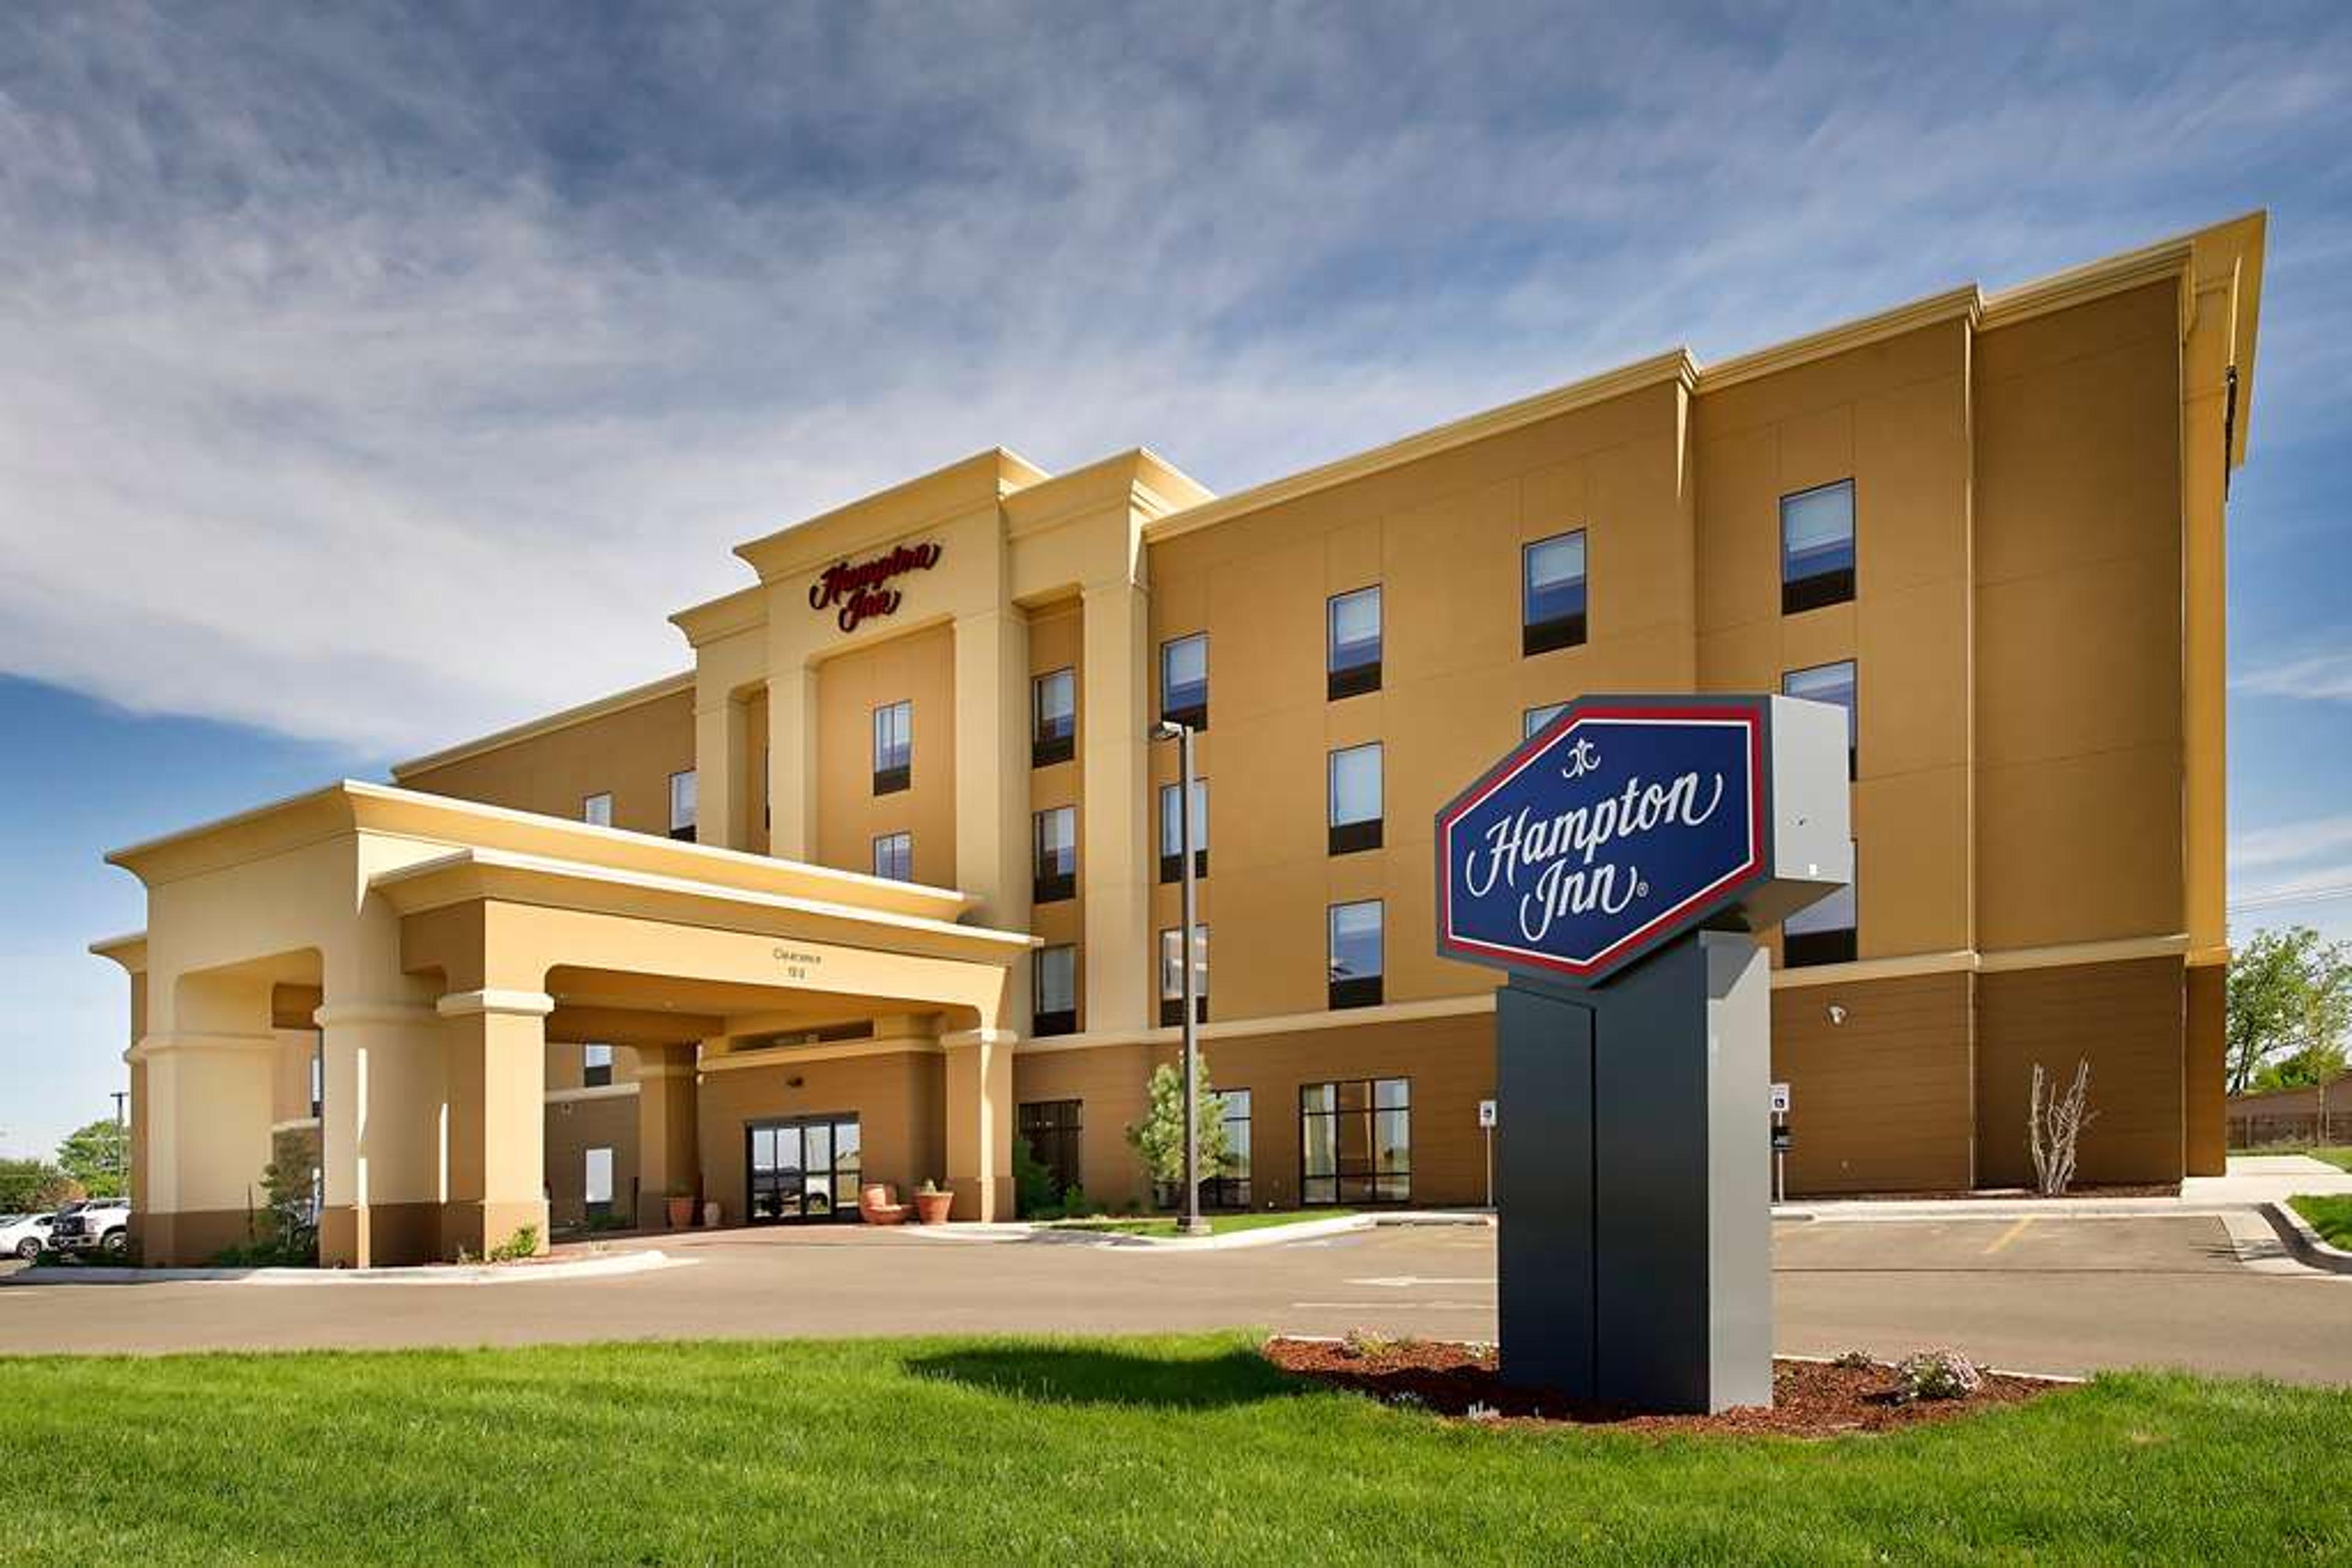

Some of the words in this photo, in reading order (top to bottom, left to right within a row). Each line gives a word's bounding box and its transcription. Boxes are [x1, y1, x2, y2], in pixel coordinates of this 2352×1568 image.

[809, 543, 941, 609] Hampton
[839, 587, 901, 632] Inn
[1466, 772, 1722, 897] Hampton
[1520, 859, 1637, 941] Inn
